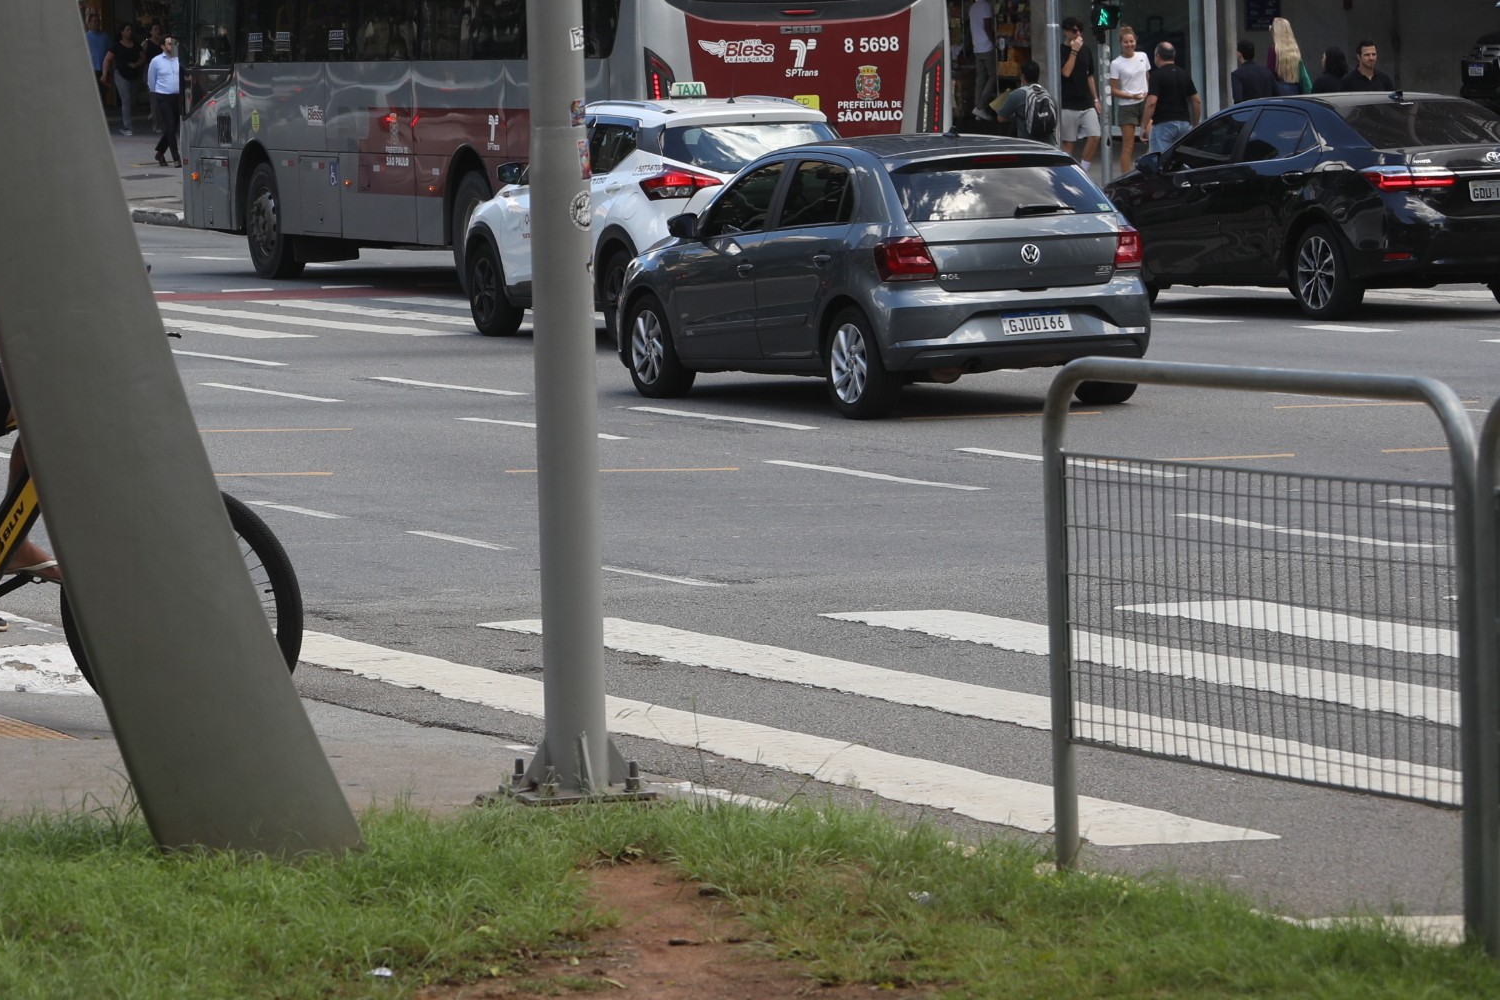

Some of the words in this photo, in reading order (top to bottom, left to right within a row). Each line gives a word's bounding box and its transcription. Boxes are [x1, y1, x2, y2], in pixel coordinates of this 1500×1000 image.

[725, 40, 775, 58] Bless
[844, 37, 854, 53] 8
[859, 36, 900, 52] 5698
[785, 68, 819, 78] SPTrans
[675, 83, 703, 96] TAXI
[837, 100, 889, 109] PREFEITURA
[890, 100, 902, 109] DE
[837, 109, 862, 122] SÃO
[864, 109, 904, 122] PAULO
[940, 273, 960, 281] GOL
